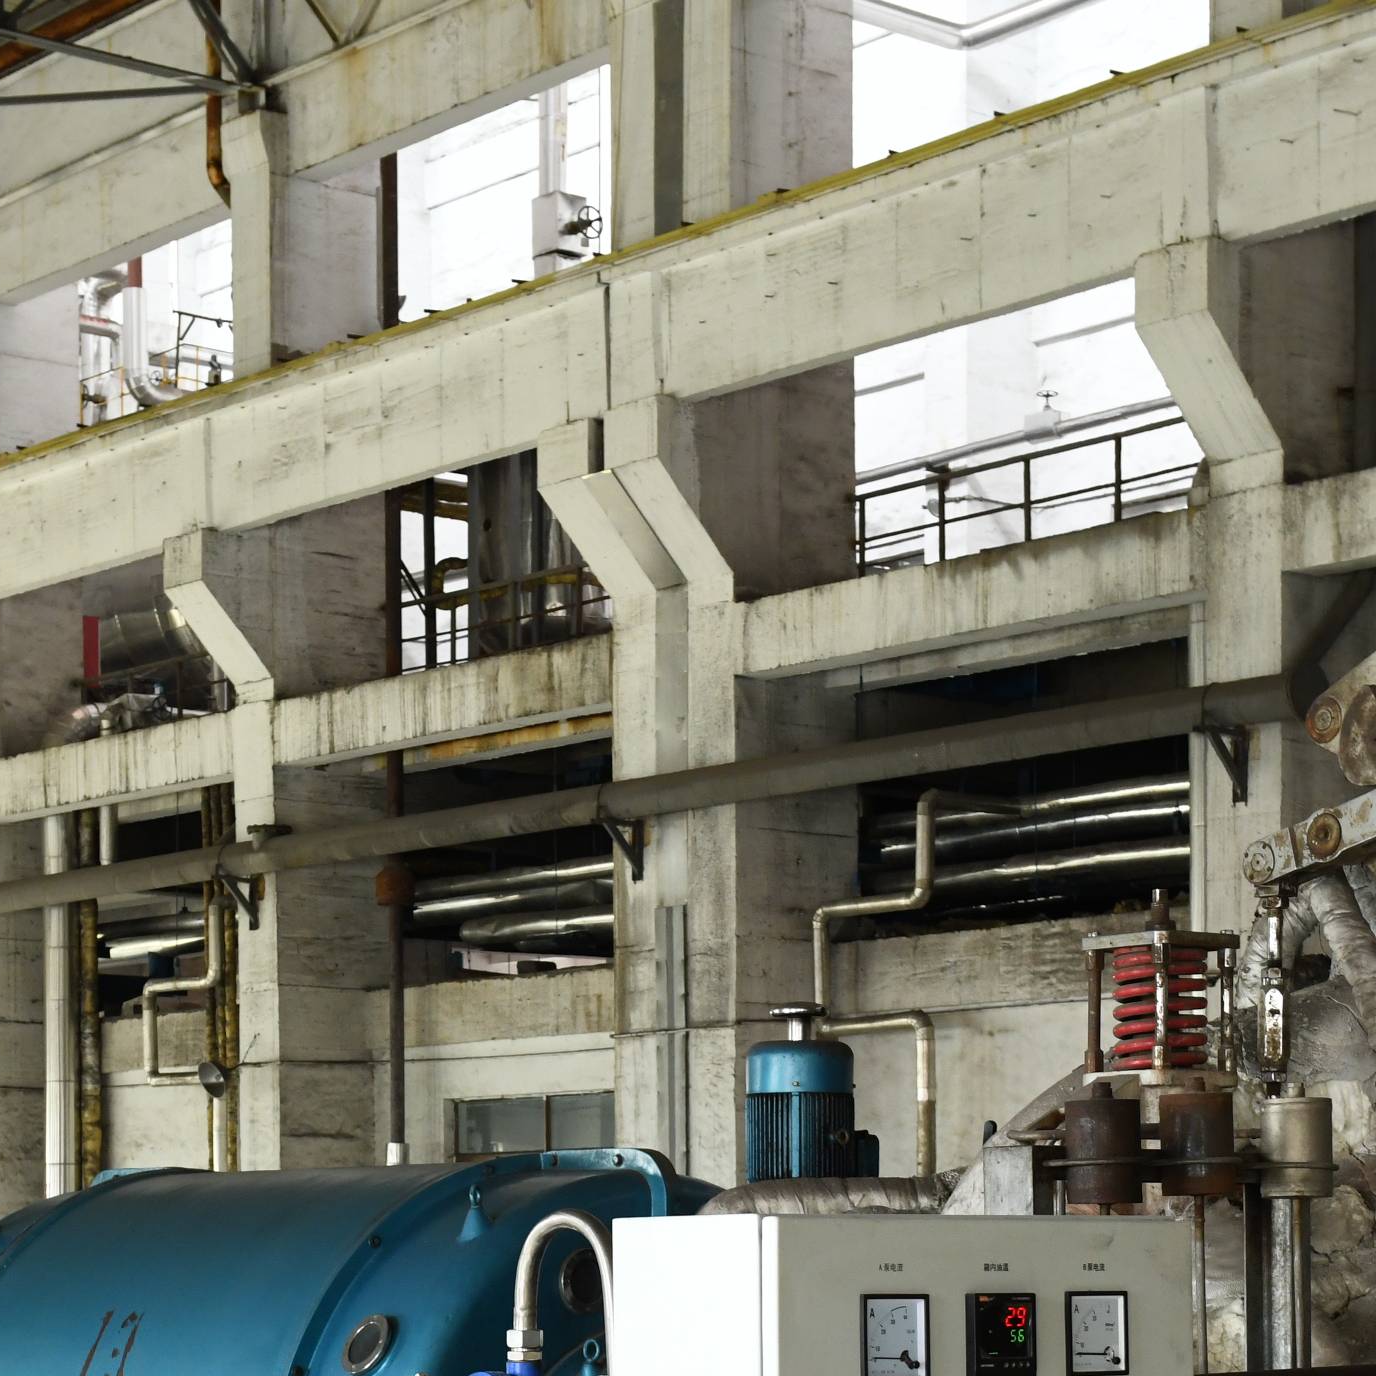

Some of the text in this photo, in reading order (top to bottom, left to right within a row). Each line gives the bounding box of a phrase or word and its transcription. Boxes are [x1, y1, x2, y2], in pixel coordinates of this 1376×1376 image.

[870, 1307, 875, 1319] A
[1005, 1306, 1026, 1327] 29
[1010, 1329, 1025, 1343] 56
